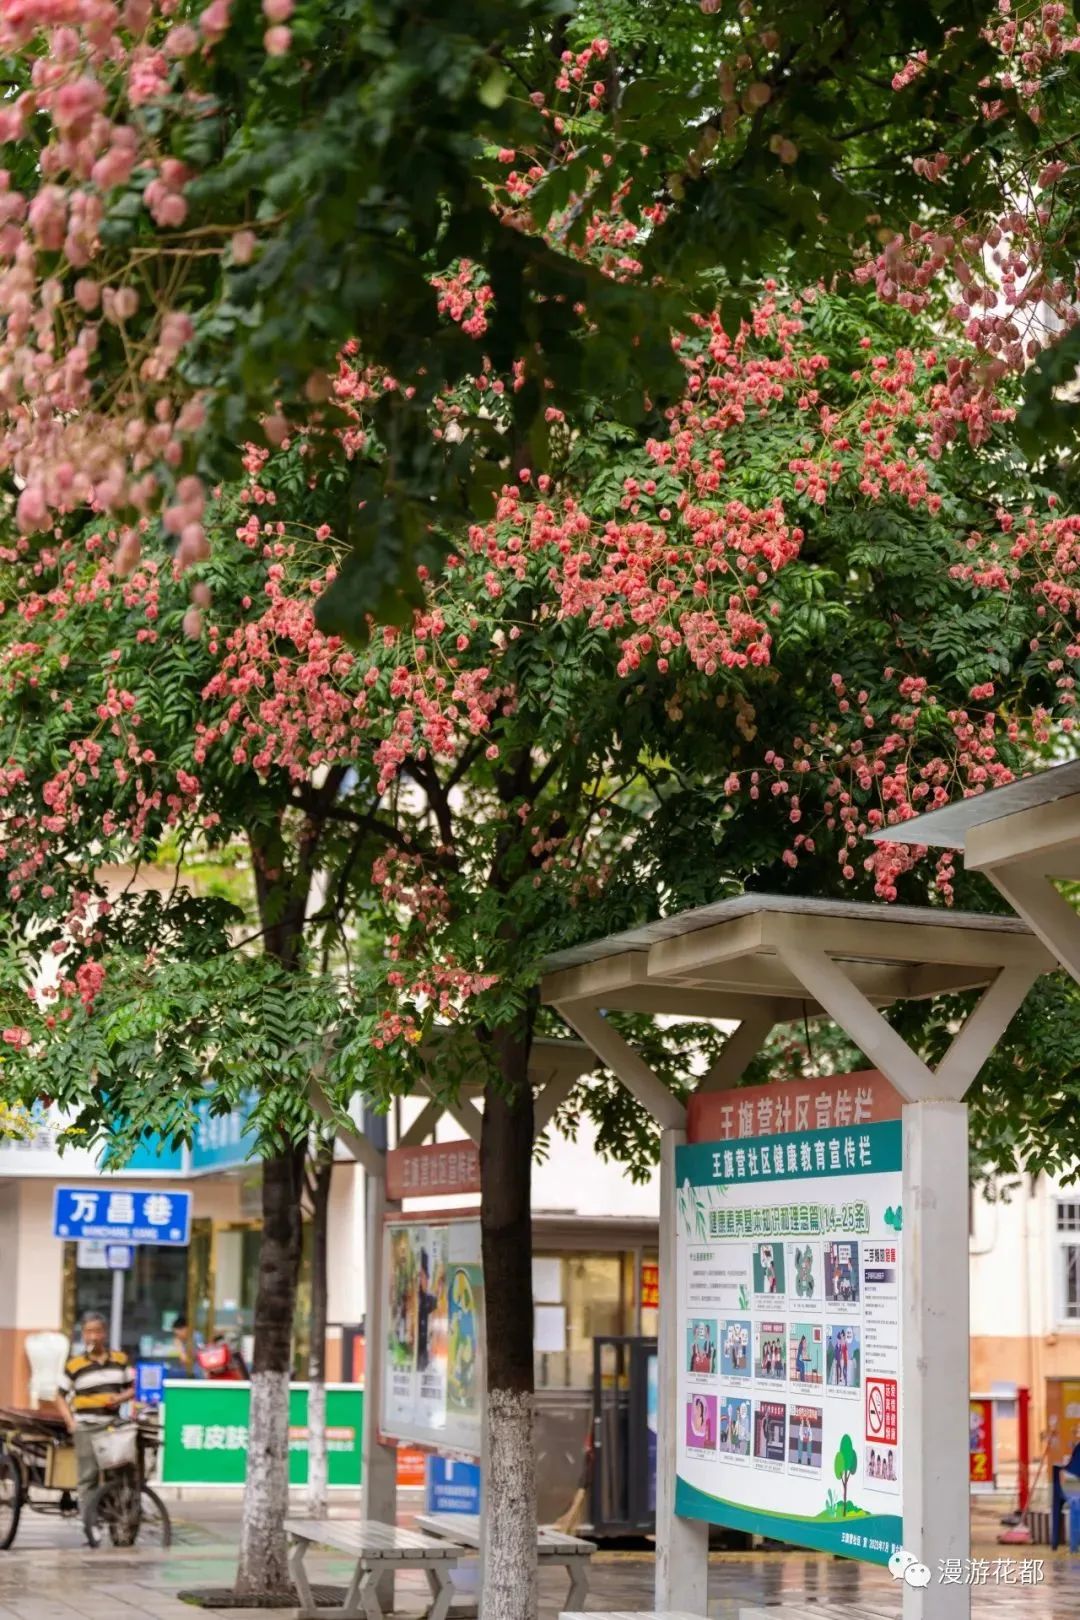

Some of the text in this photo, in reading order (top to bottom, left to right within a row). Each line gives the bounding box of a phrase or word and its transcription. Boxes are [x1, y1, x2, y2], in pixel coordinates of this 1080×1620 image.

[720, 1087, 873, 1141] 王旗营社区宣传栏
[712, 1135, 872, 1178] 王旗营社区健康教育宣传栏
[69, 1192, 174, 1225] 万昌巷
[181, 1424, 250, 1450] 看皮肤
